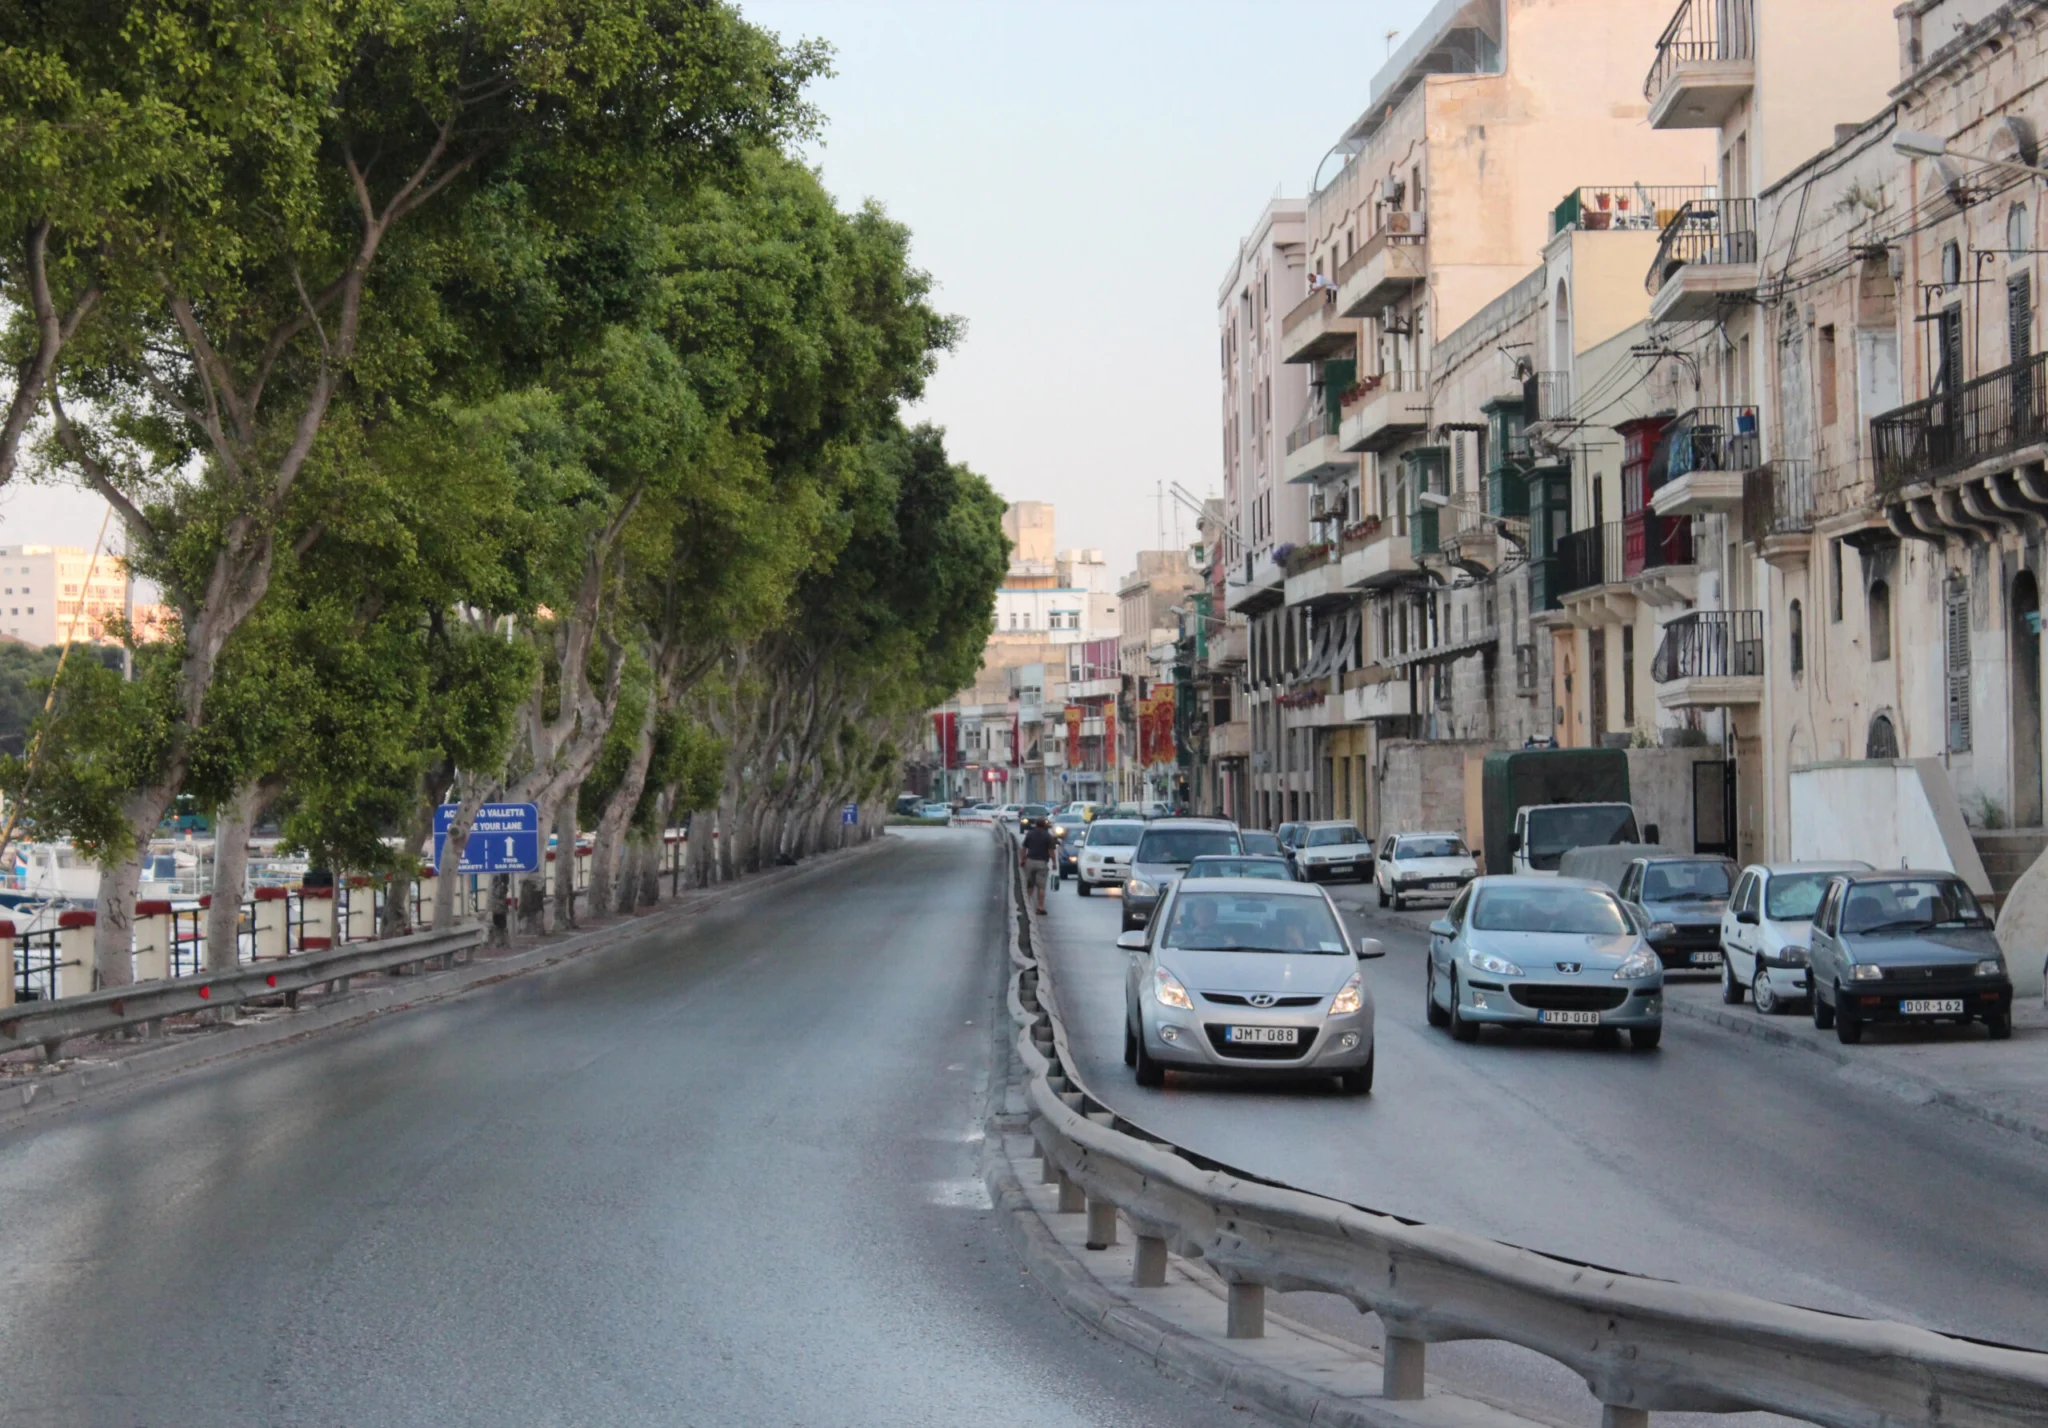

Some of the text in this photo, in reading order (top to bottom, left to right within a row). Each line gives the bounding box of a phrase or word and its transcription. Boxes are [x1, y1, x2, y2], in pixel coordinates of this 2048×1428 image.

[487, 808, 525, 818] VALLETTA
[480, 822, 501, 831] YOUR
[502, 821, 523, 830] LANE
